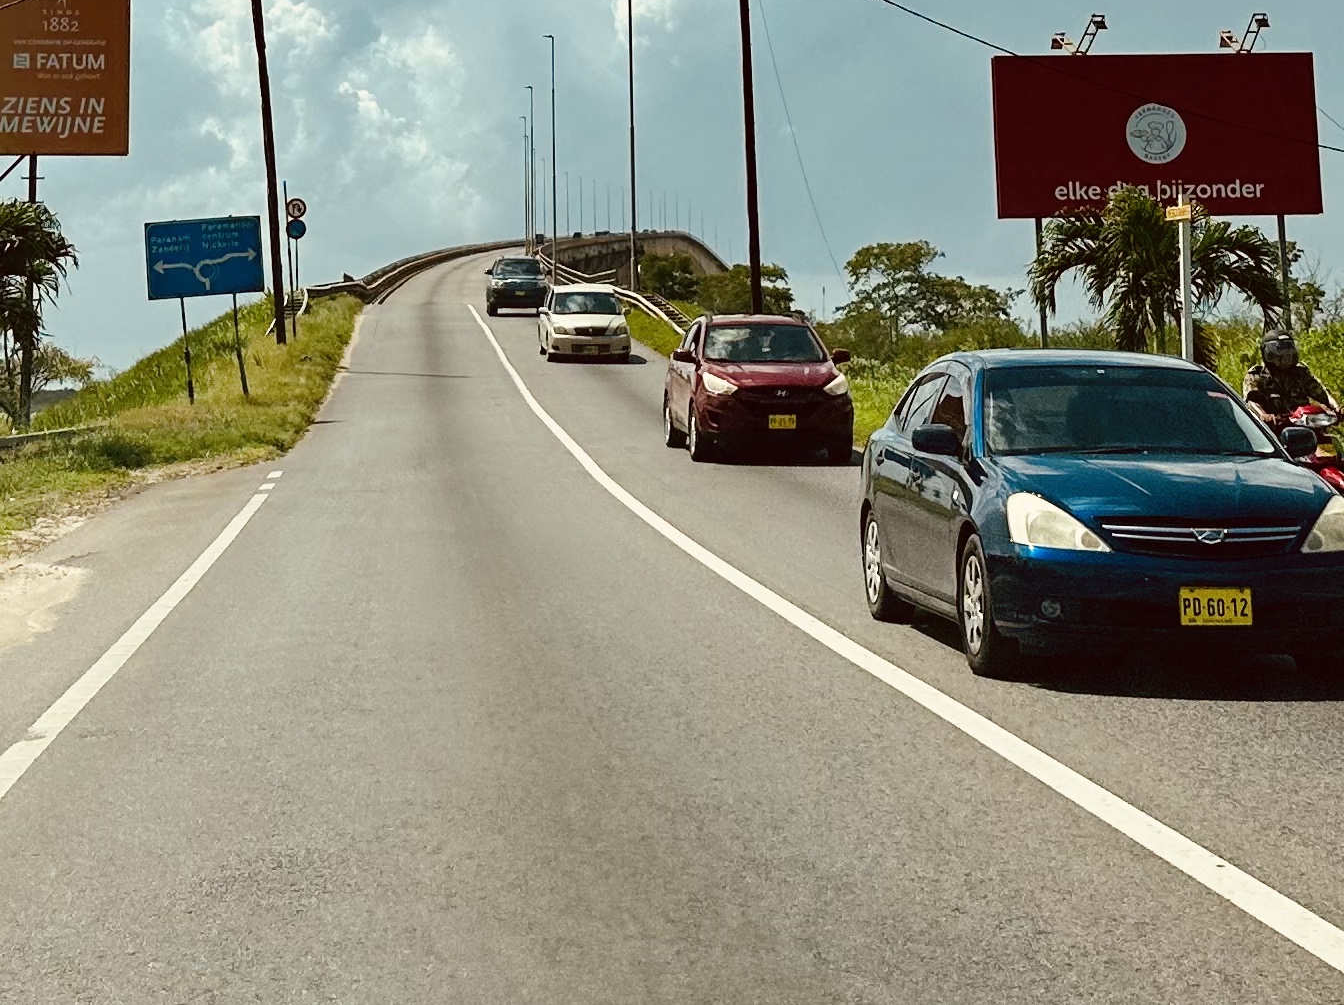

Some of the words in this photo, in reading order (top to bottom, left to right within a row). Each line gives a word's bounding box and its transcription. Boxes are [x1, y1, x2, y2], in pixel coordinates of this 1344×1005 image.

[42, 17, 80, 32] 1882
[36, 53, 105, 70] FATUM
[0, 97, 71, 114] ZIENS
[79, 97, 105, 114] IN
[1054, 181, 1101, 201] elke
[1156, 178, 1265, 202] bijzonder
